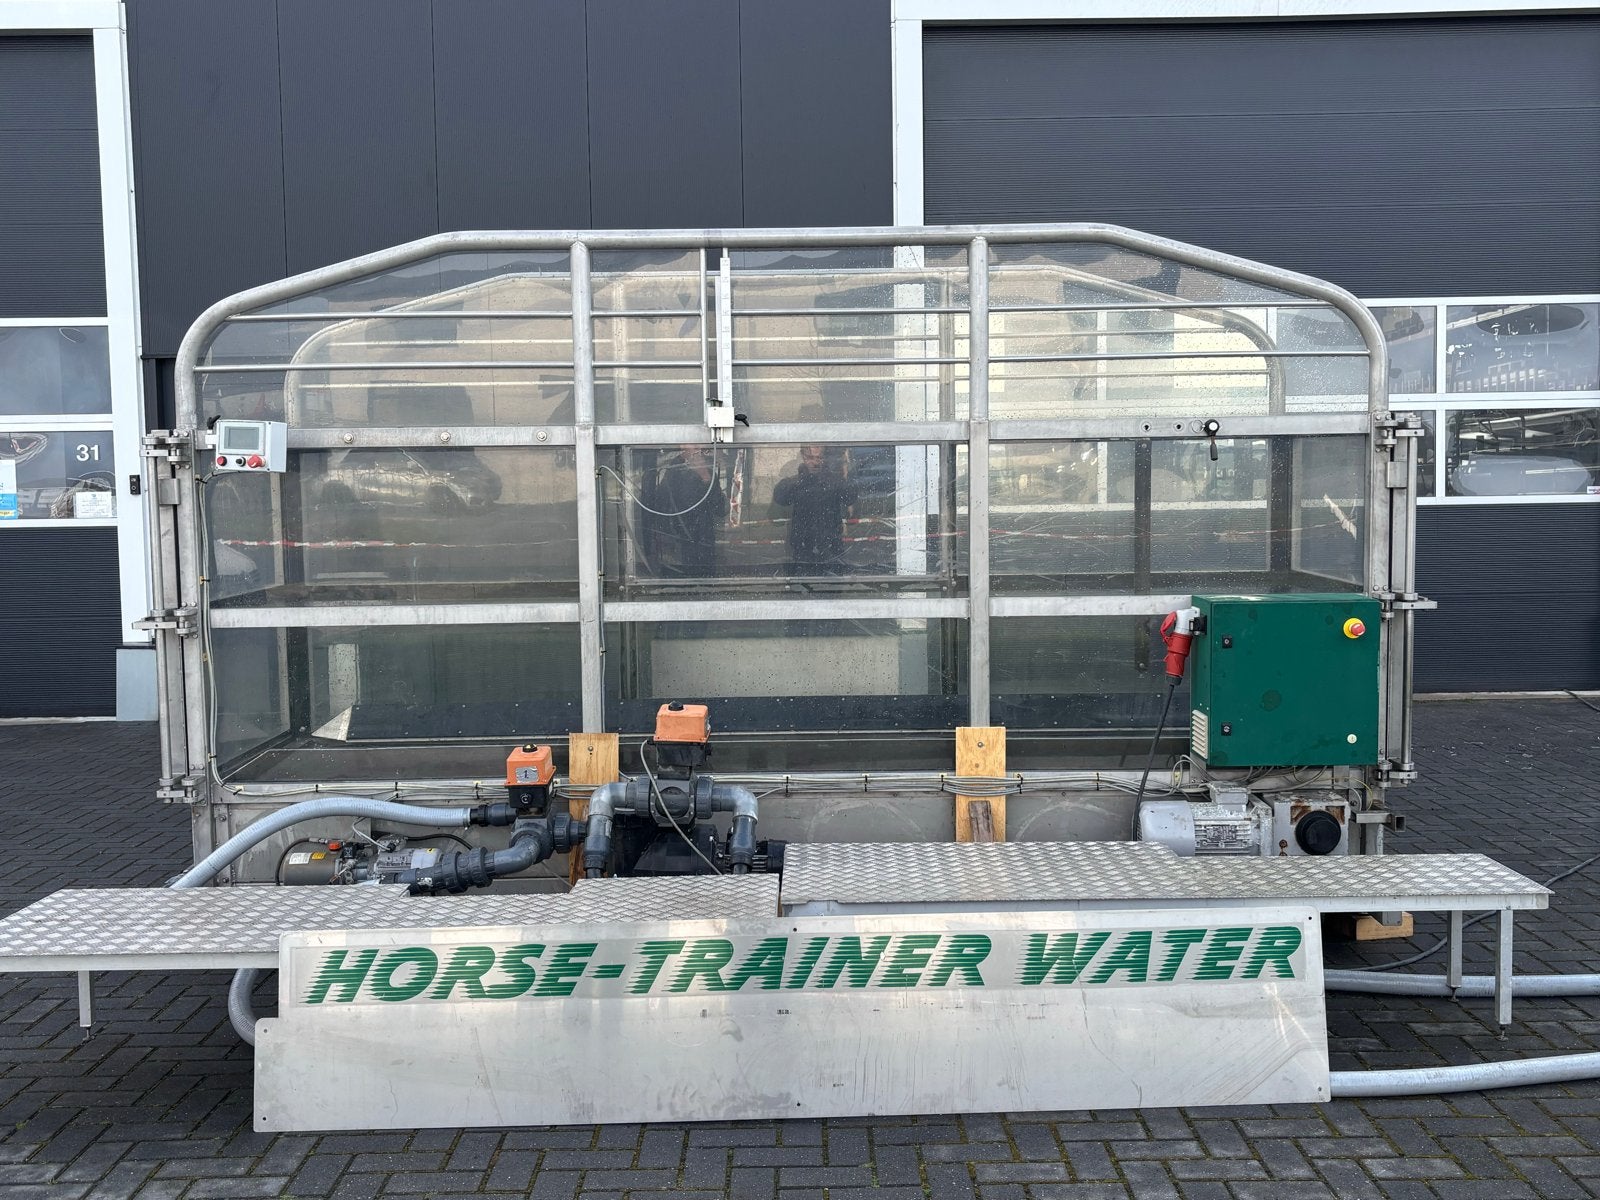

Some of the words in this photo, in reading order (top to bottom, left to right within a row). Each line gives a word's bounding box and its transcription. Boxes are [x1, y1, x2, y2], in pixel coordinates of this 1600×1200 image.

[76, 444, 100, 461] 31
[299, 934, 992, 1004] HORSE-TRAINER
[1013, 926, 1302, 985] WATER
